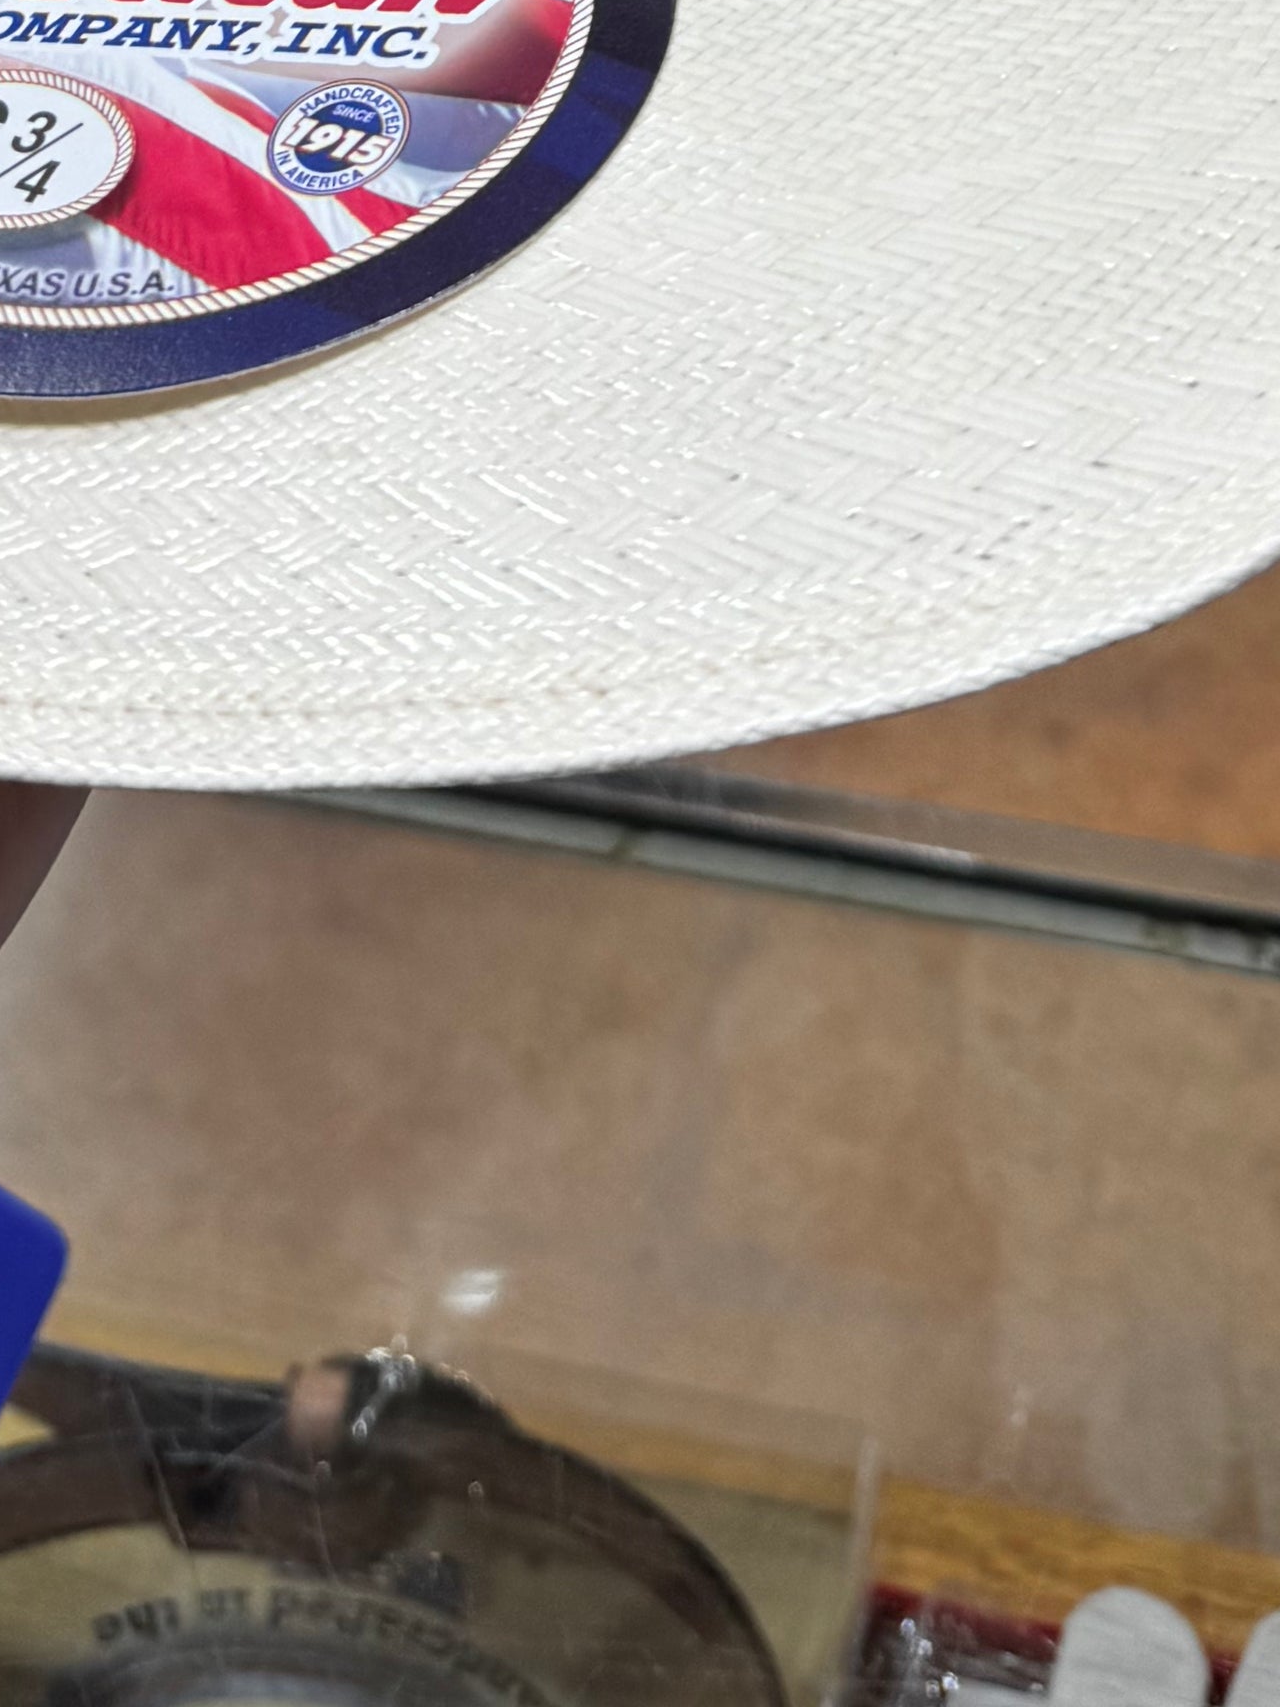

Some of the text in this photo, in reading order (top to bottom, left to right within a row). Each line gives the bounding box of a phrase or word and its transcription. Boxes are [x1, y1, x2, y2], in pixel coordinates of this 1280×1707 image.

[272, 21, 428, 60] INC.
[298, 86, 401, 135] HANDCRAFTED
[332, 103, 376, 124] SINCE
[280, 116, 397, 166] 1915
[275, 149, 365, 189] IN AMERICA
[73, 270, 176, 299] U.S.A.
